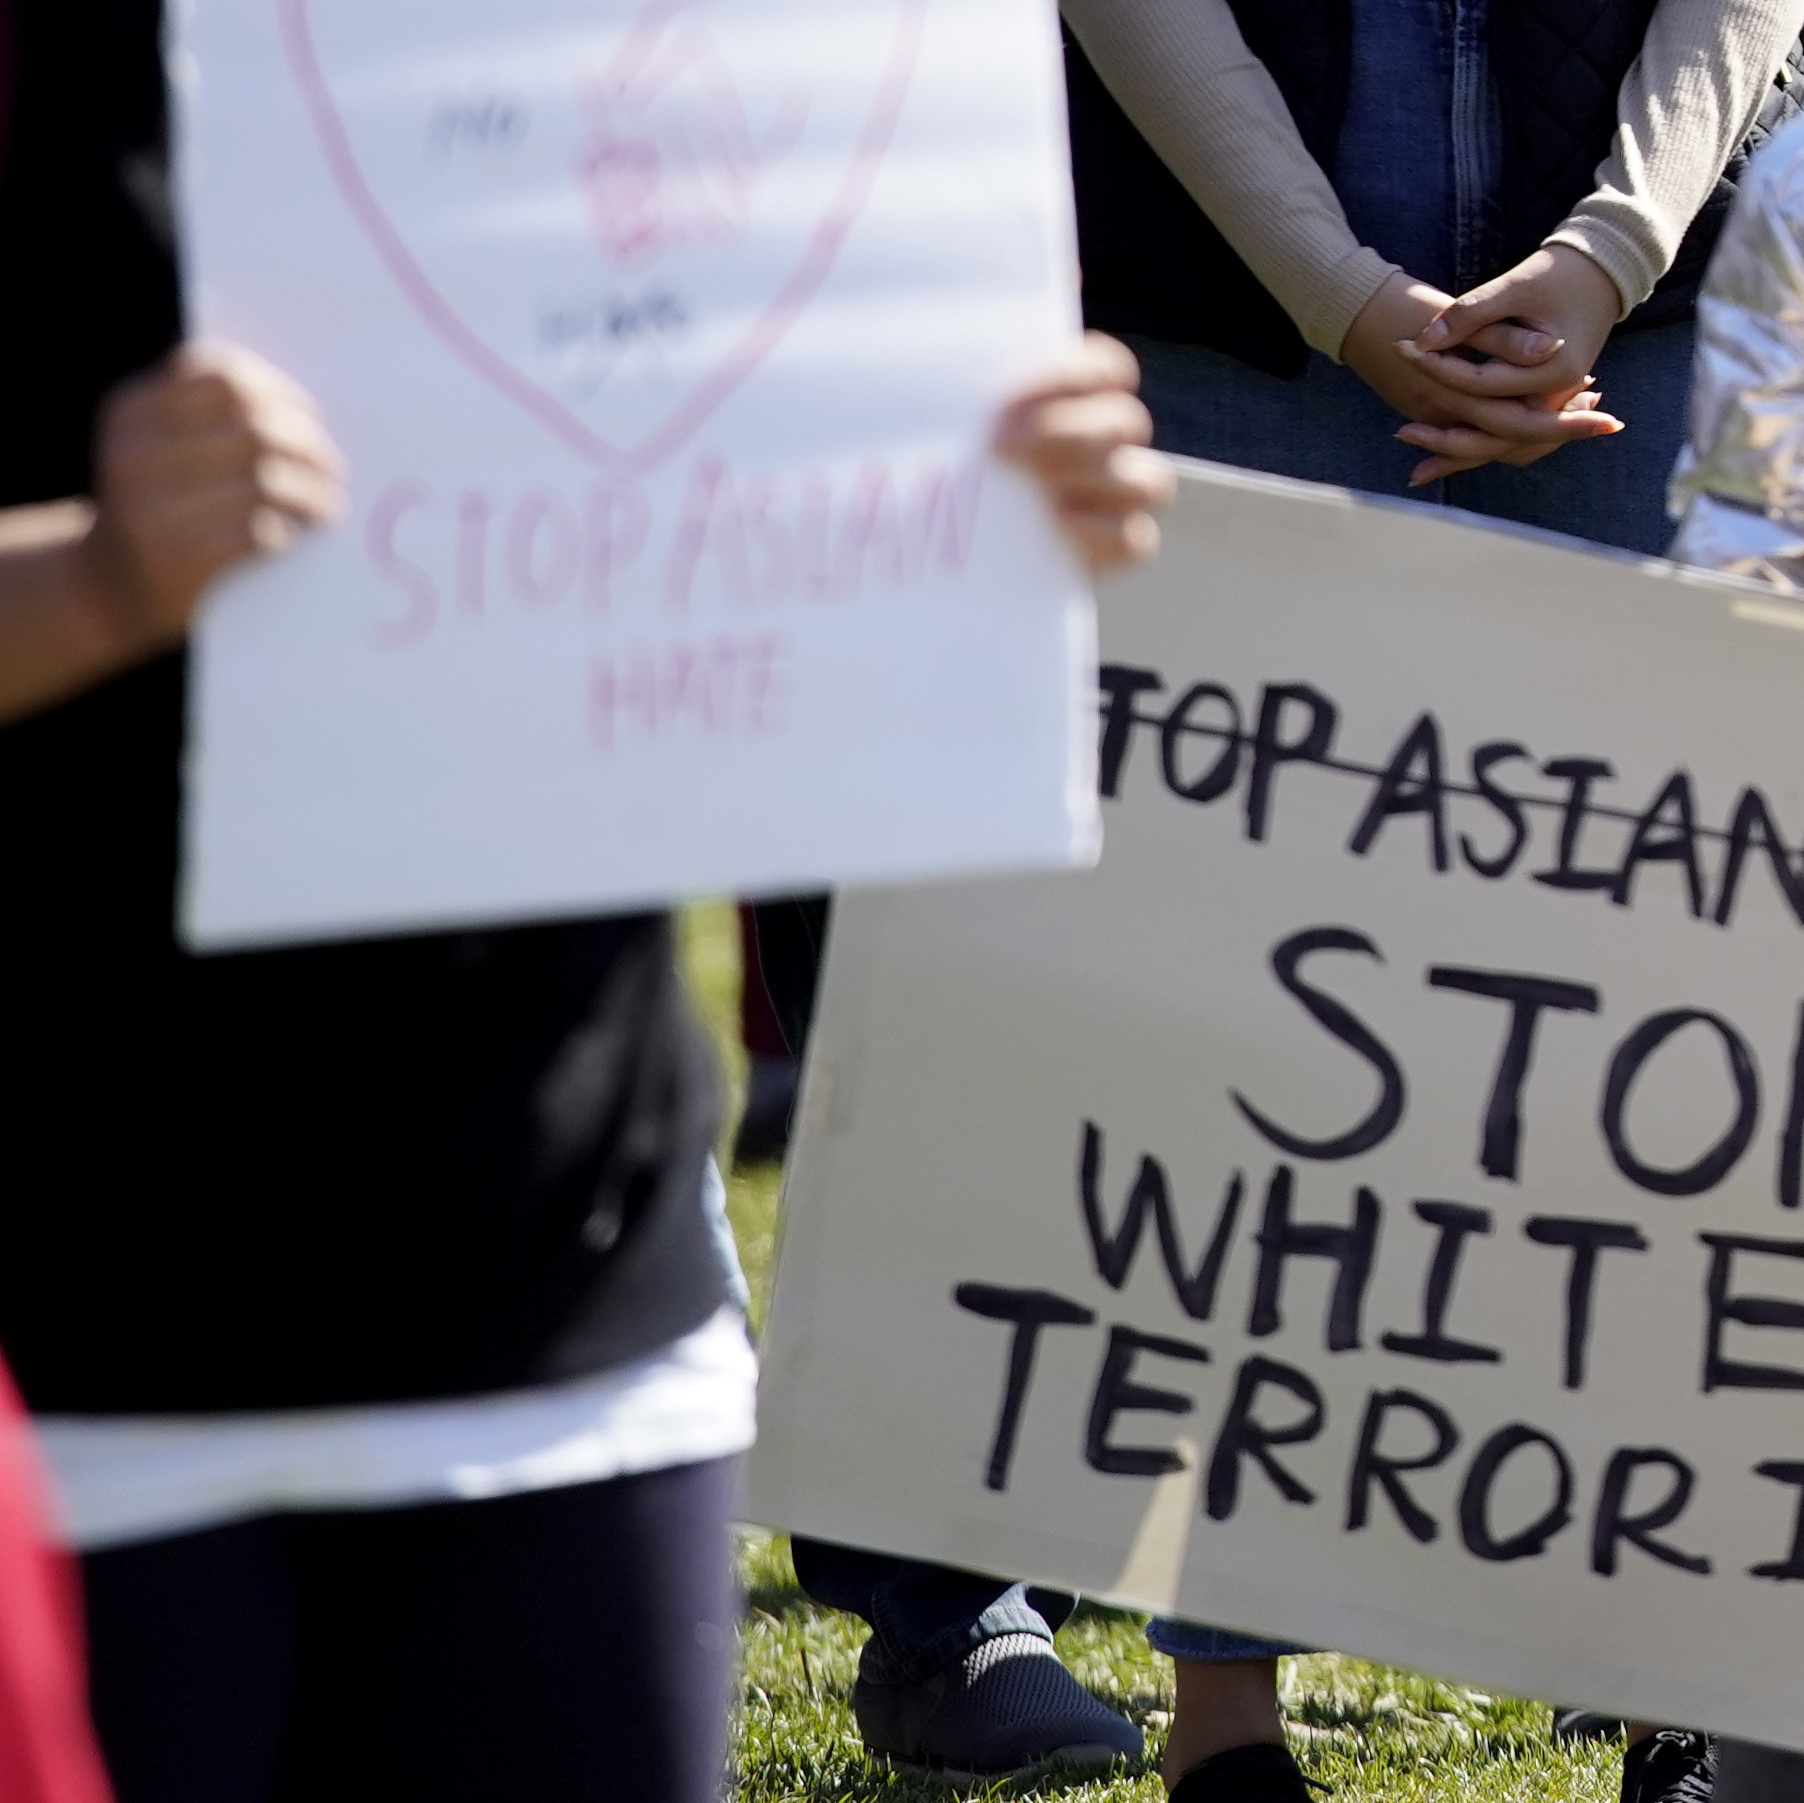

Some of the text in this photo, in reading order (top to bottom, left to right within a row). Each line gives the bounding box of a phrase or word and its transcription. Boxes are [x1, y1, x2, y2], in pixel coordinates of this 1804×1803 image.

[363, 472, 653, 654] STOP
[584, 630, 796, 760] HATE
[1098, 663, 1338, 843] TOP
